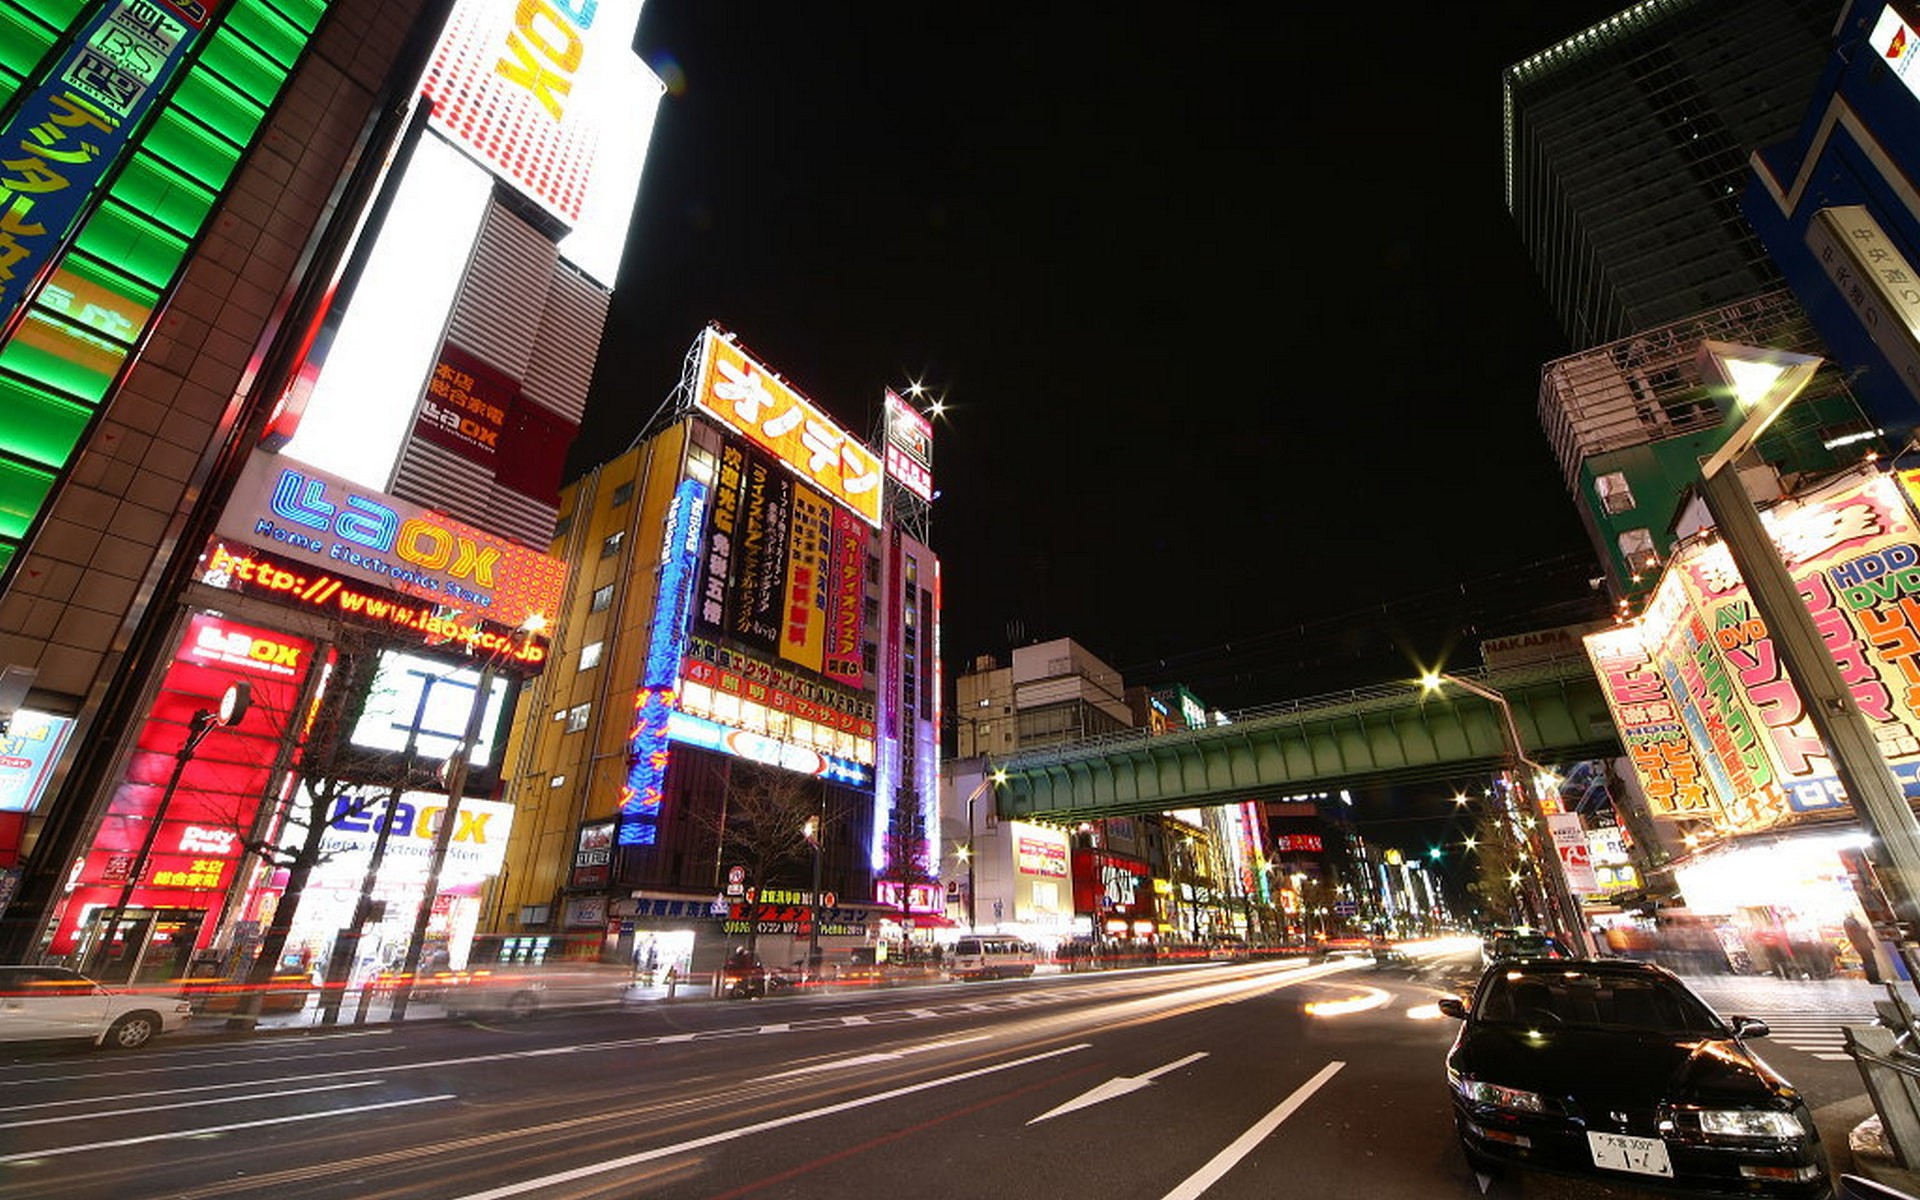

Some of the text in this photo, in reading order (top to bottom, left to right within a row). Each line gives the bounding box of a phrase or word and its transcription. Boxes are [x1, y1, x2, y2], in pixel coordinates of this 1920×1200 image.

[712, 358, 878, 494] オノデン
[255, 519, 492, 607] Home Electronics Store
[1830, 544, 1917, 589] HDD
[1842, 567, 1920, 610] DVD
[1716, 601, 1746, 631] AV
[1716, 618, 1768, 650] DVD
[1725, 637, 1827, 777] ソフト
[179, 838, 231, 854] Free
[185, 826, 237, 843] Duty
